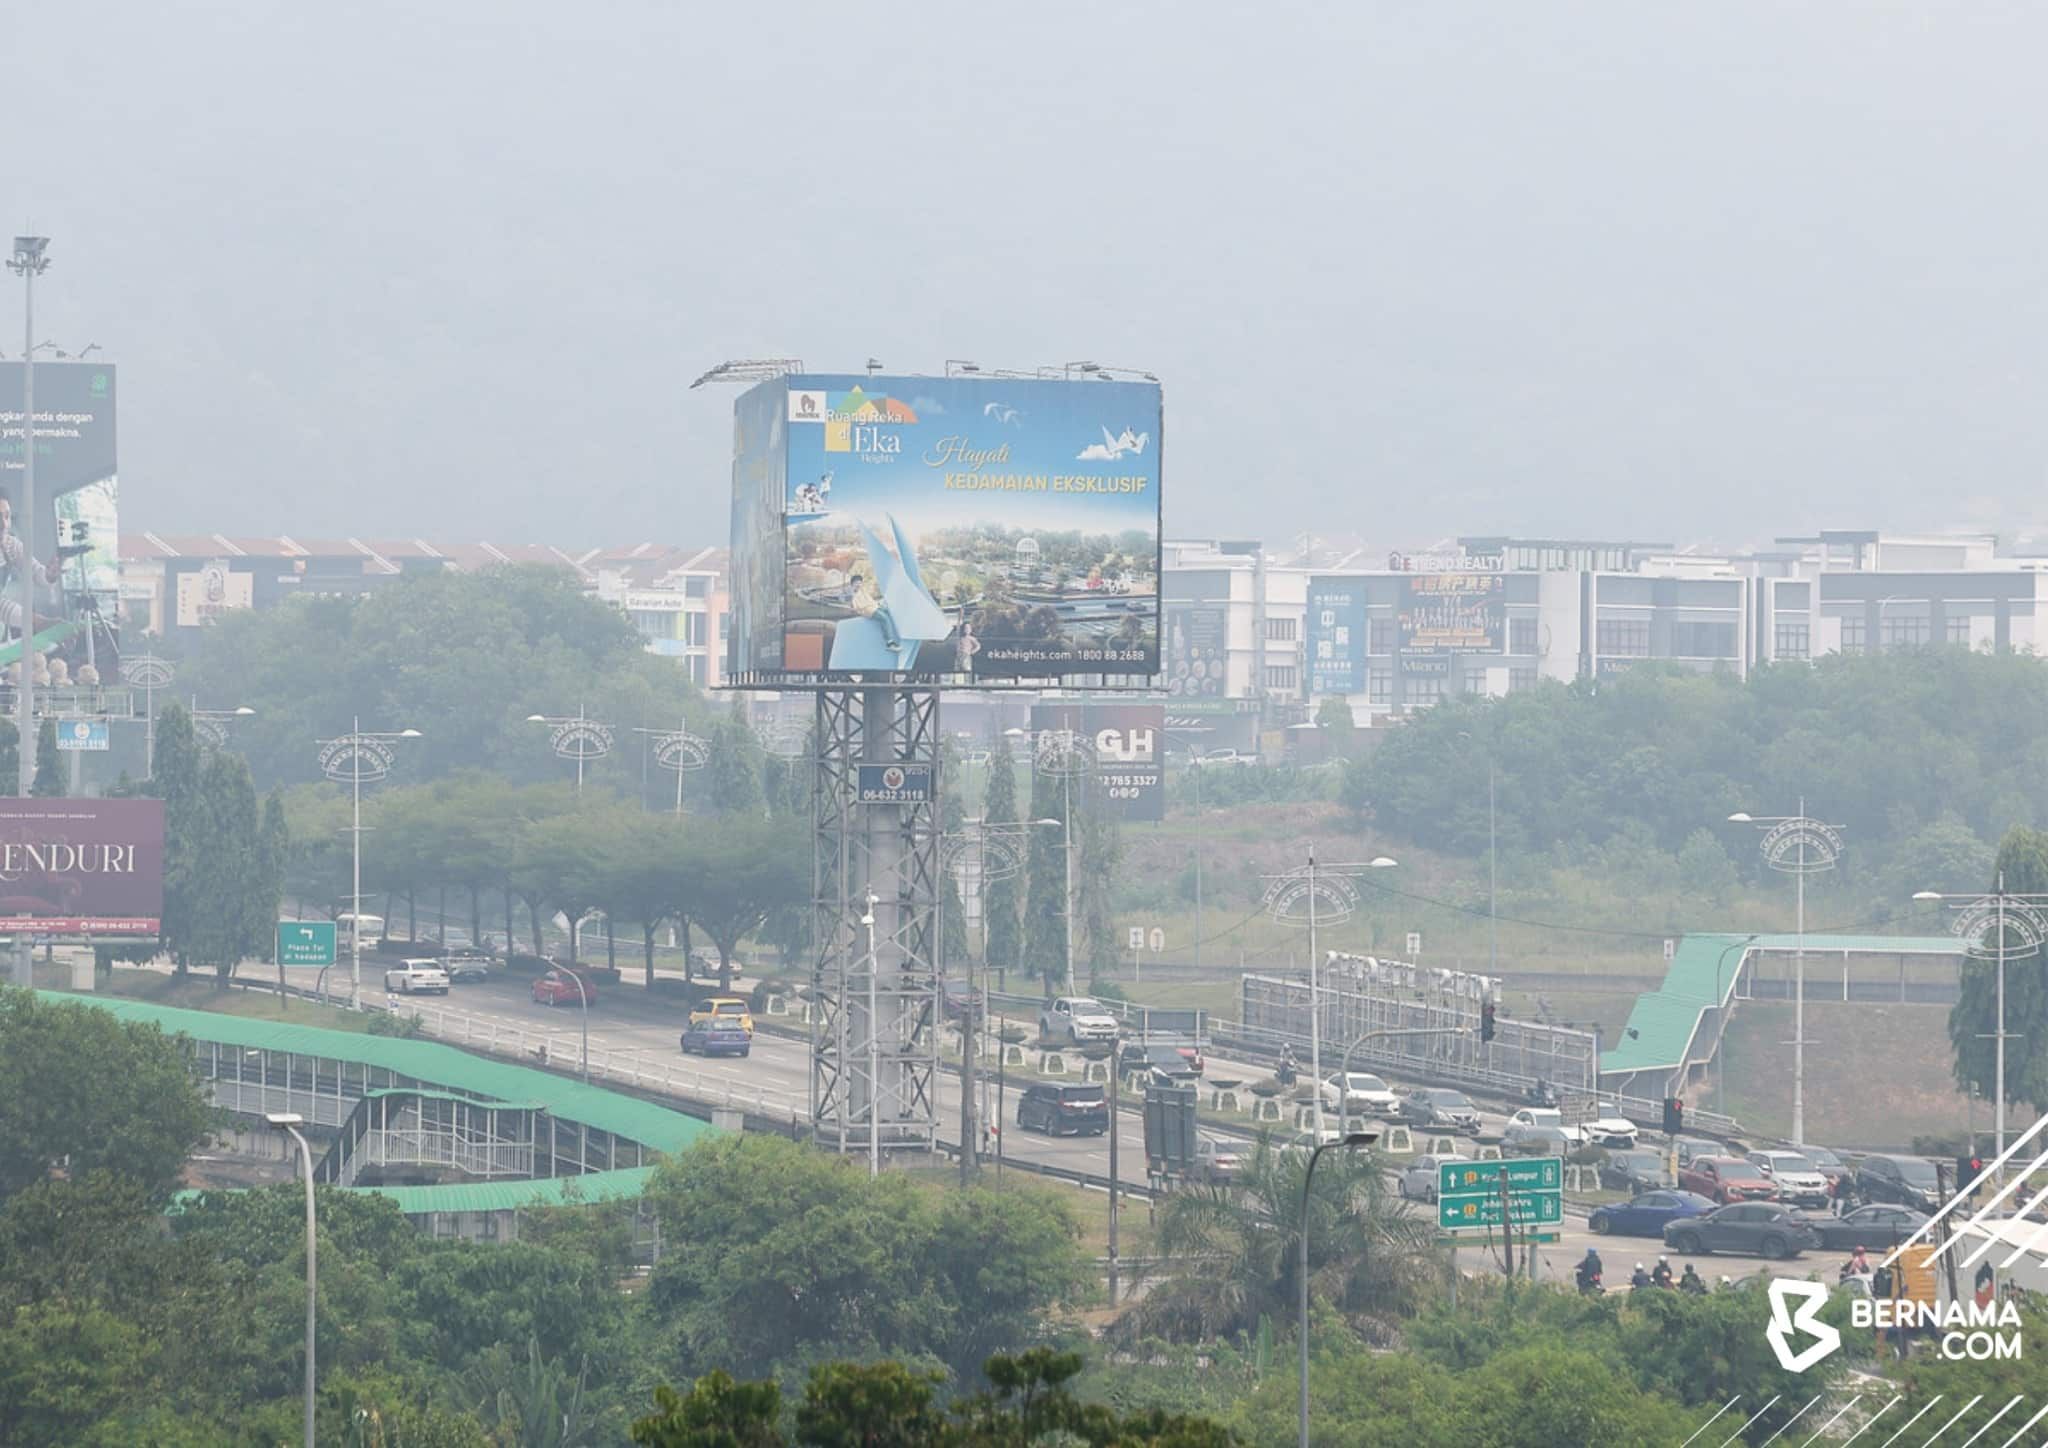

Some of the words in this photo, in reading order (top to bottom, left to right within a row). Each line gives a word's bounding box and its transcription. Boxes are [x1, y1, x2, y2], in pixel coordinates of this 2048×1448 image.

[56, 411, 94, 425] dengan
[854, 426, 902, 453] Eka
[922, 435, 1011, 471] Hayati
[943, 472, 1049, 491] KEDAMAIAN
[1053, 475, 1149, 494] EKSKLUSIF
[987, 649, 1072, 662] ekaheights.com
[1078, 650, 1101, 661] 1800
